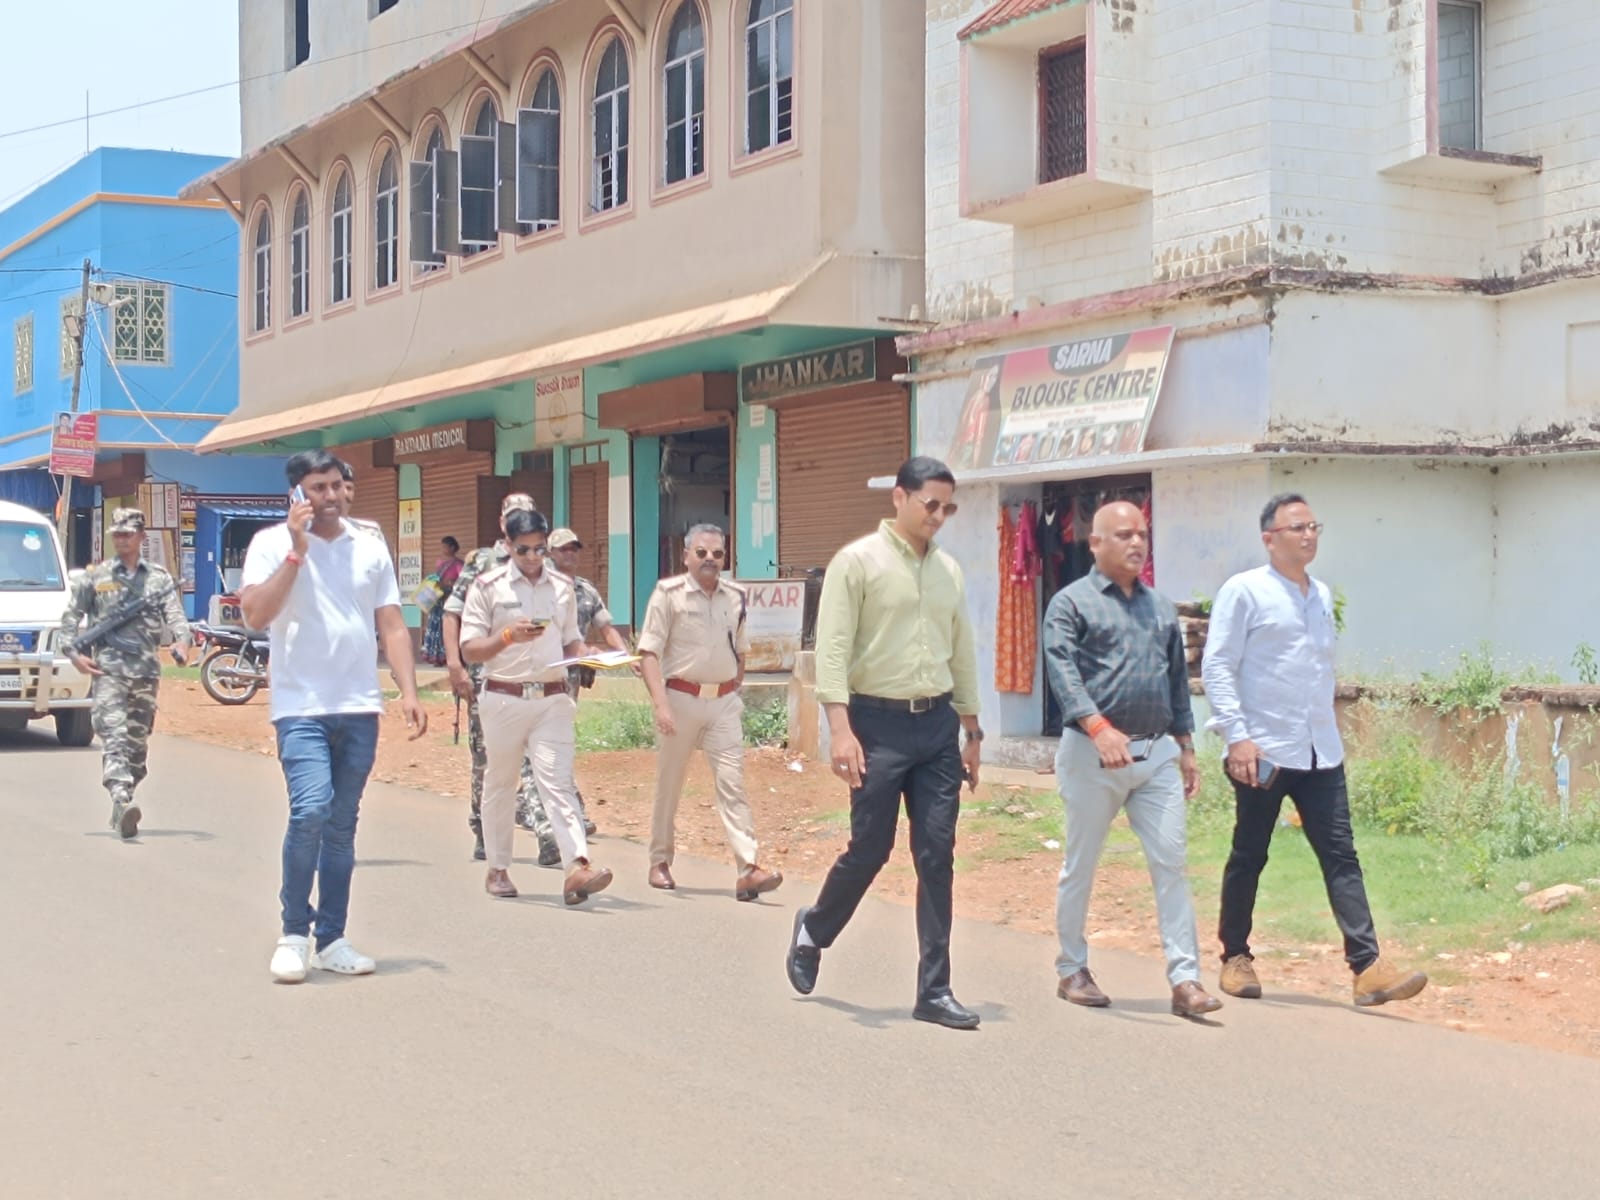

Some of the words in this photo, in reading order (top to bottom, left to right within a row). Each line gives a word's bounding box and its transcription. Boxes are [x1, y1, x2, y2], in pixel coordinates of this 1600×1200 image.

[1054, 337, 1114, 371] SARNA
[748, 348, 865, 394] JHANKAR
[1010, 378, 1081, 413] BLOUSE
[1083, 366, 1158, 402] CENTRE
[431, 427, 466, 449] MEDICAL
[400, 556, 420, 569] MEDICAL
[400, 572, 420, 586] STORE
